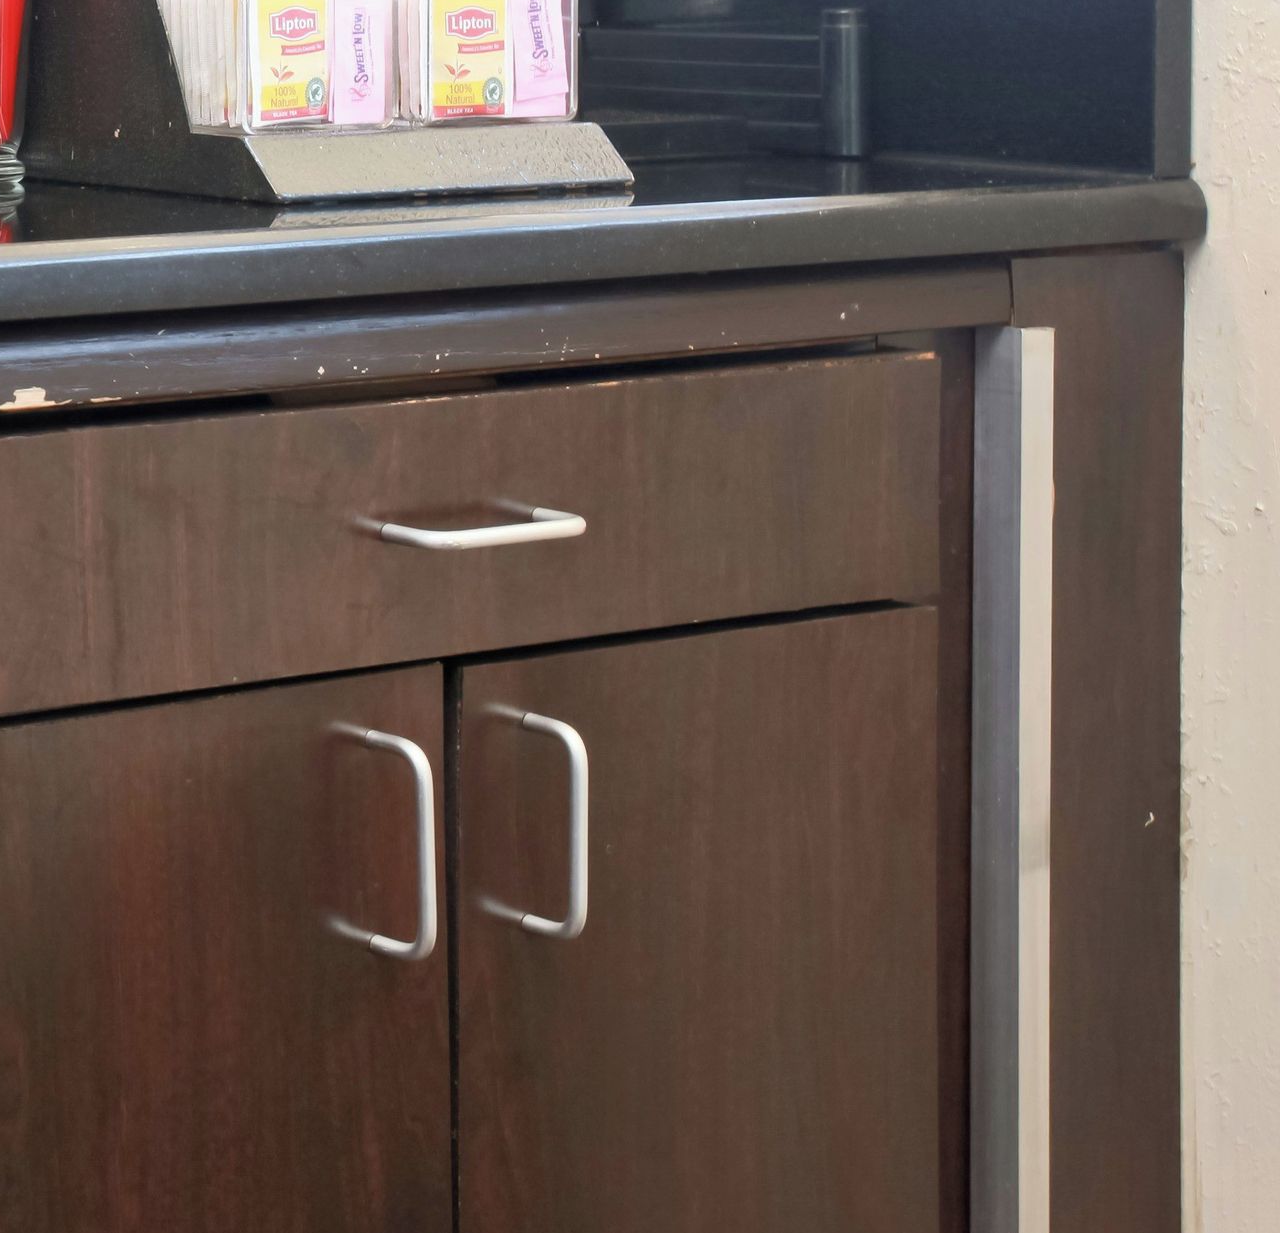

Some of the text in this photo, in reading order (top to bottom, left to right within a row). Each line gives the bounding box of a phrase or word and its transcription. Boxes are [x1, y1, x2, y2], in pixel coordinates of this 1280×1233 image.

[274, 16, 314, 34] Lipton
[451, 15, 493, 34] Lipton
[274, 86, 297, 96] 100%
[450, 83, 473, 94] 100%
[270, 96, 299, 108] Natural
[446, 94, 475, 105] Natural
